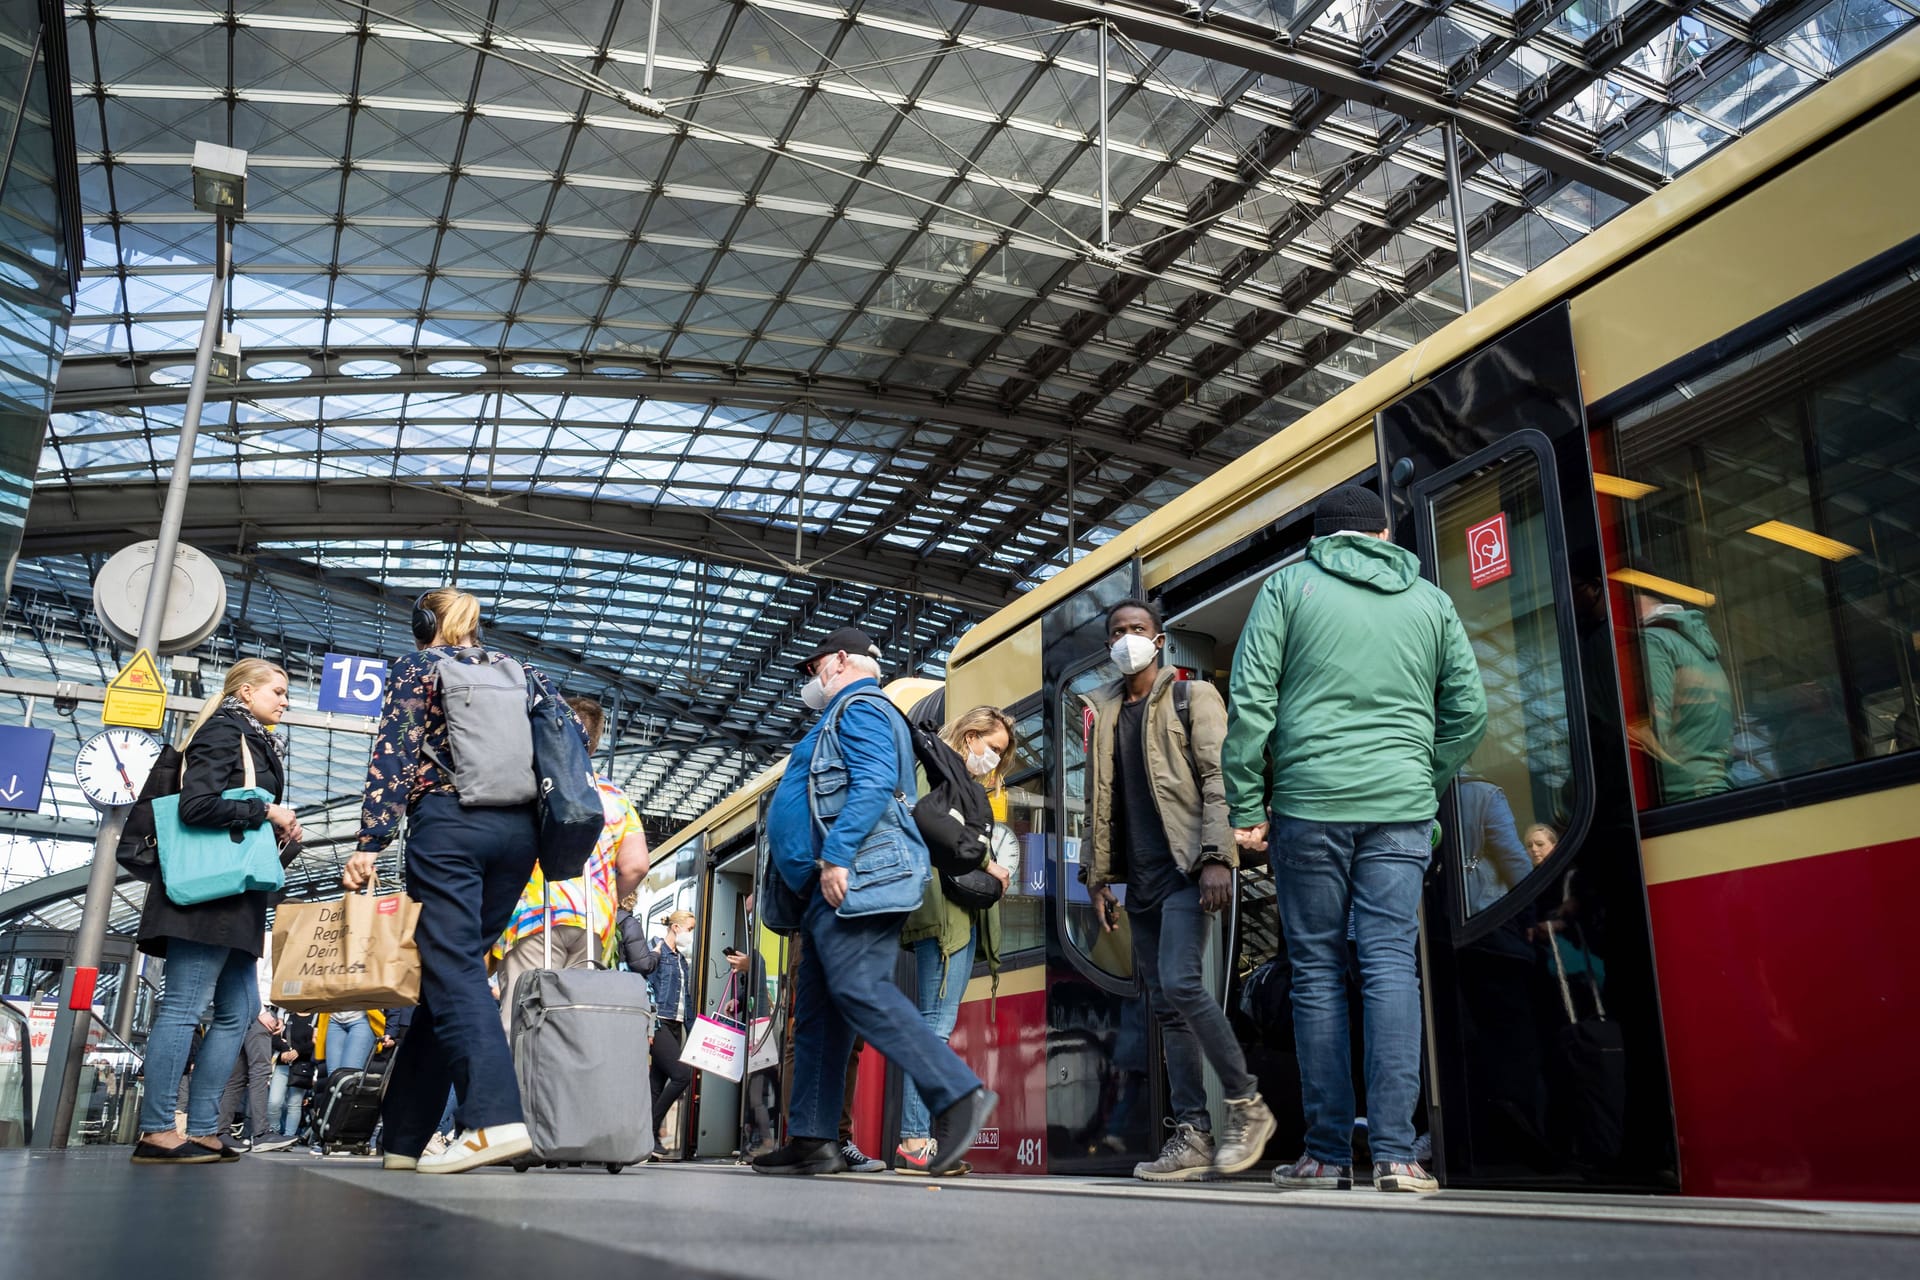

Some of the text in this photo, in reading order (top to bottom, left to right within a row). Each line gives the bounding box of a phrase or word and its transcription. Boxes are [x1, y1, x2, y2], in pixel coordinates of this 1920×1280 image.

[332, 658, 383, 701] 15
[306, 944, 338, 958] Dein
[1017, 1138, 1042, 1166] 481
